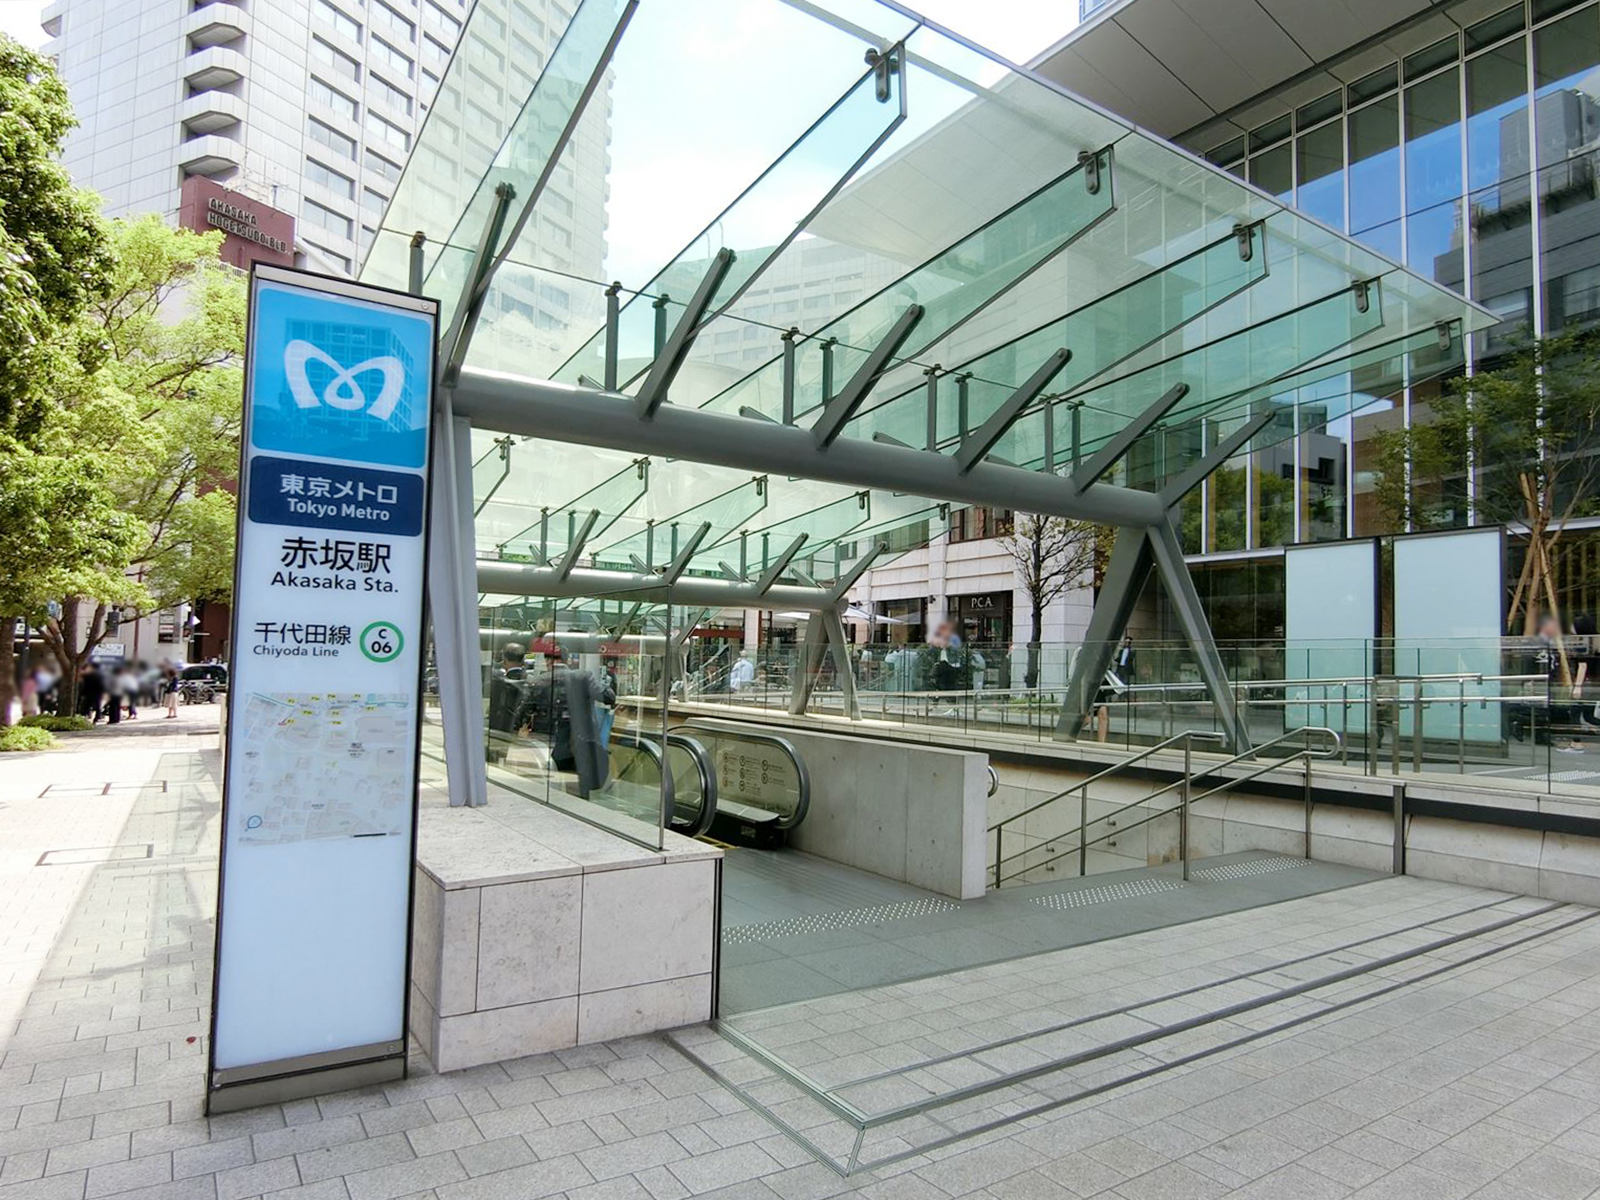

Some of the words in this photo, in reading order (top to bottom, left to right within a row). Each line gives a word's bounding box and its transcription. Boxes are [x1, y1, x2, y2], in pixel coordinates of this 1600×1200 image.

[208, 197, 257, 226] AKASAKA
[280, 474, 398, 504] 東京メトロ
[287, 497, 337, 518] Tokyo
[341, 503, 390, 520] Metro
[281, 536, 392, 574] 赤坂駅
[271, 571, 356, 591] Akasaka
[364, 577, 399, 593] Sta.
[254, 622, 351, 646] 千代田線
[378, 628, 388, 639] C
[253, 644, 308, 658] Chiyoda
[312, 646, 339, 657] Line
[371, 641, 392, 654] 06
